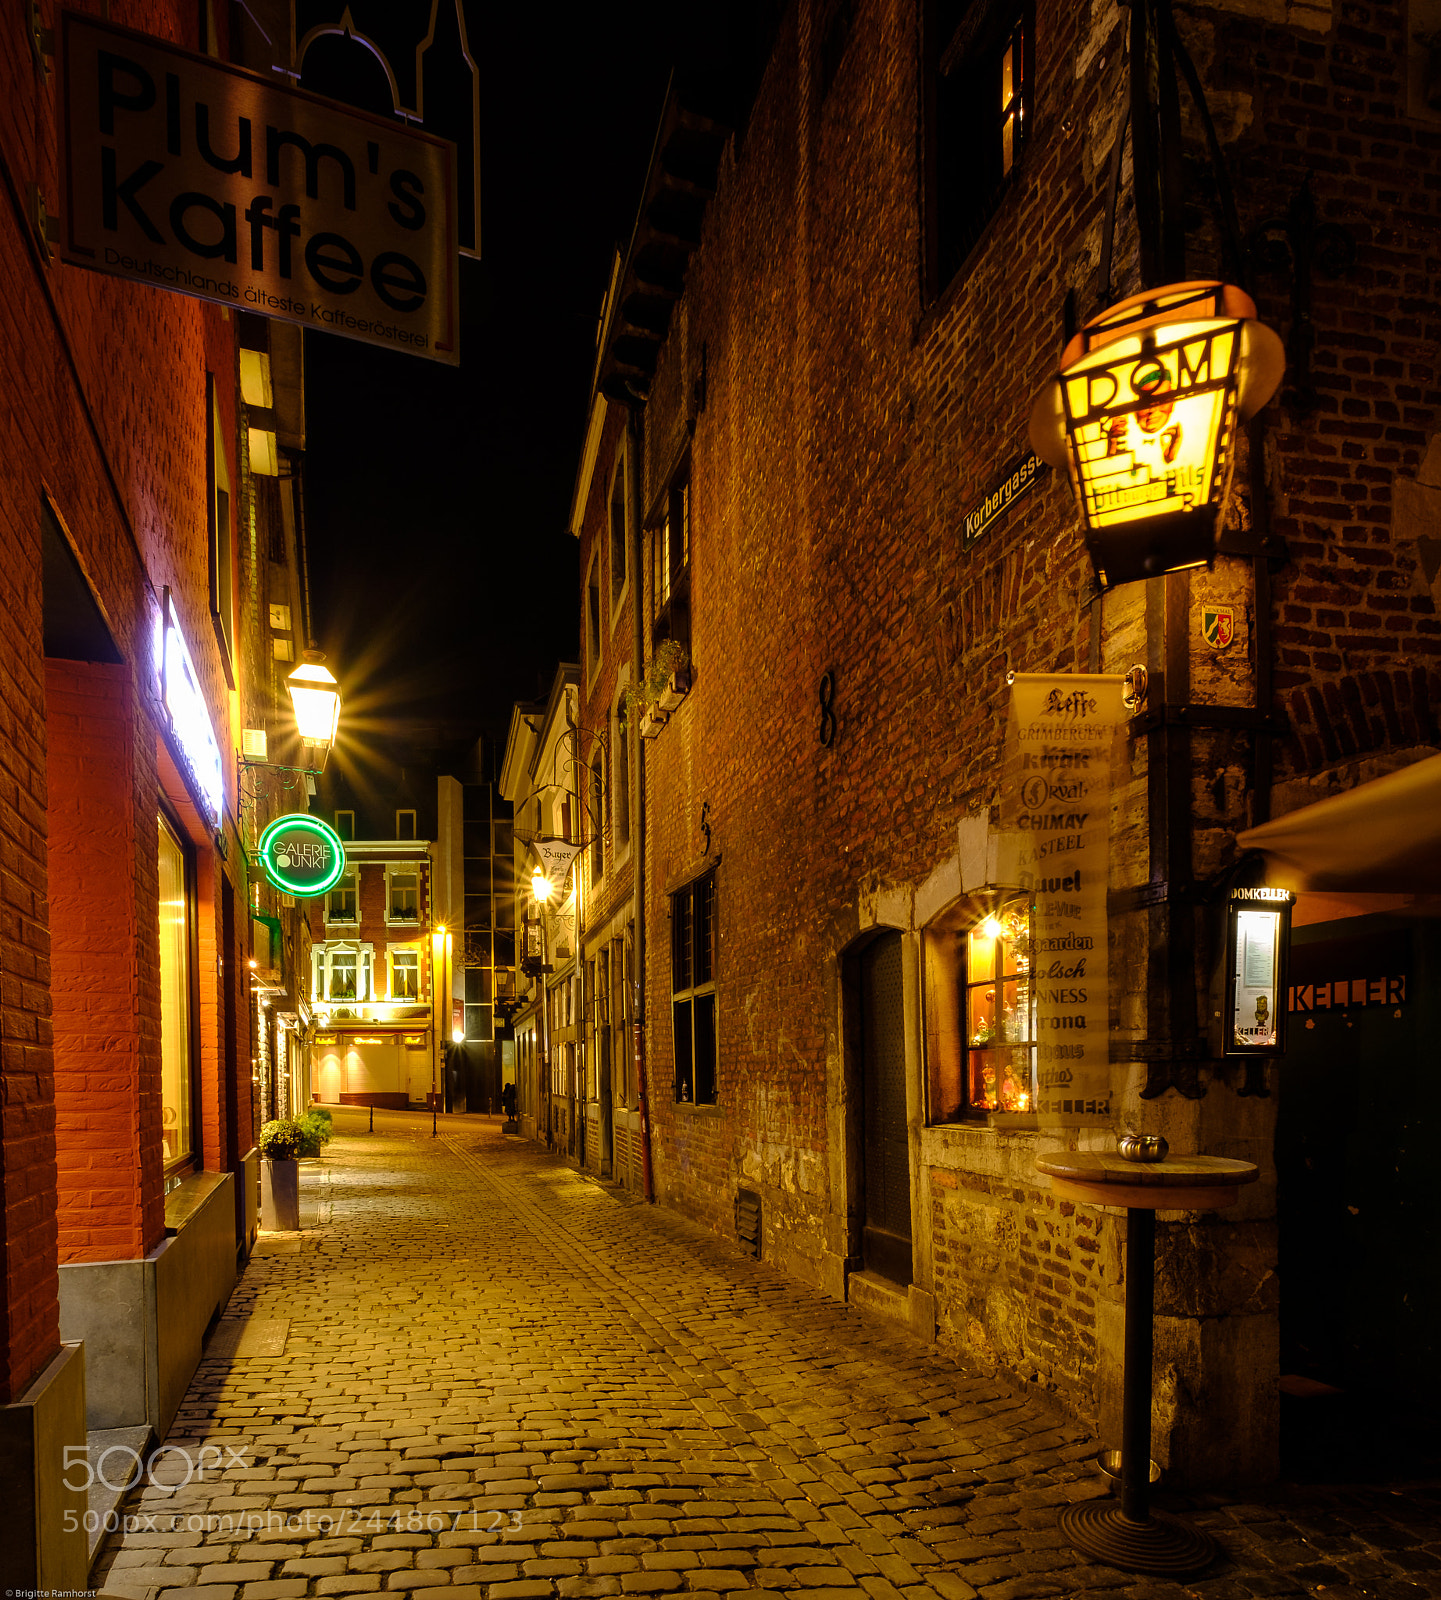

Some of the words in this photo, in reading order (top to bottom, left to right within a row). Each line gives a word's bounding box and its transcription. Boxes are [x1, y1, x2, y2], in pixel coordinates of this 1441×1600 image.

[98, 49, 427, 231] Plum's
[101, 146, 428, 313] Kaffee
[104, 247, 240, 299] Deutschlands
[244, 285, 306, 316] älteste
[311, 303, 429, 349] Kaffeerösterei
[1088, 338, 1213, 410] DOM
[1017, 727, 1103, 741] GRIMBERGEN
[1015, 813, 1090, 831] CHIMAY
[272, 841, 331, 858] GALERIE
[1018, 834, 1086, 866] KASTEEL
[1018, 869, 1082, 894] Duvel
[1230, 887, 1290, 901] DOMKELLER
[1291, 975, 1406, 1011] KELLER
[1040, 1014, 1087, 1030] rona
